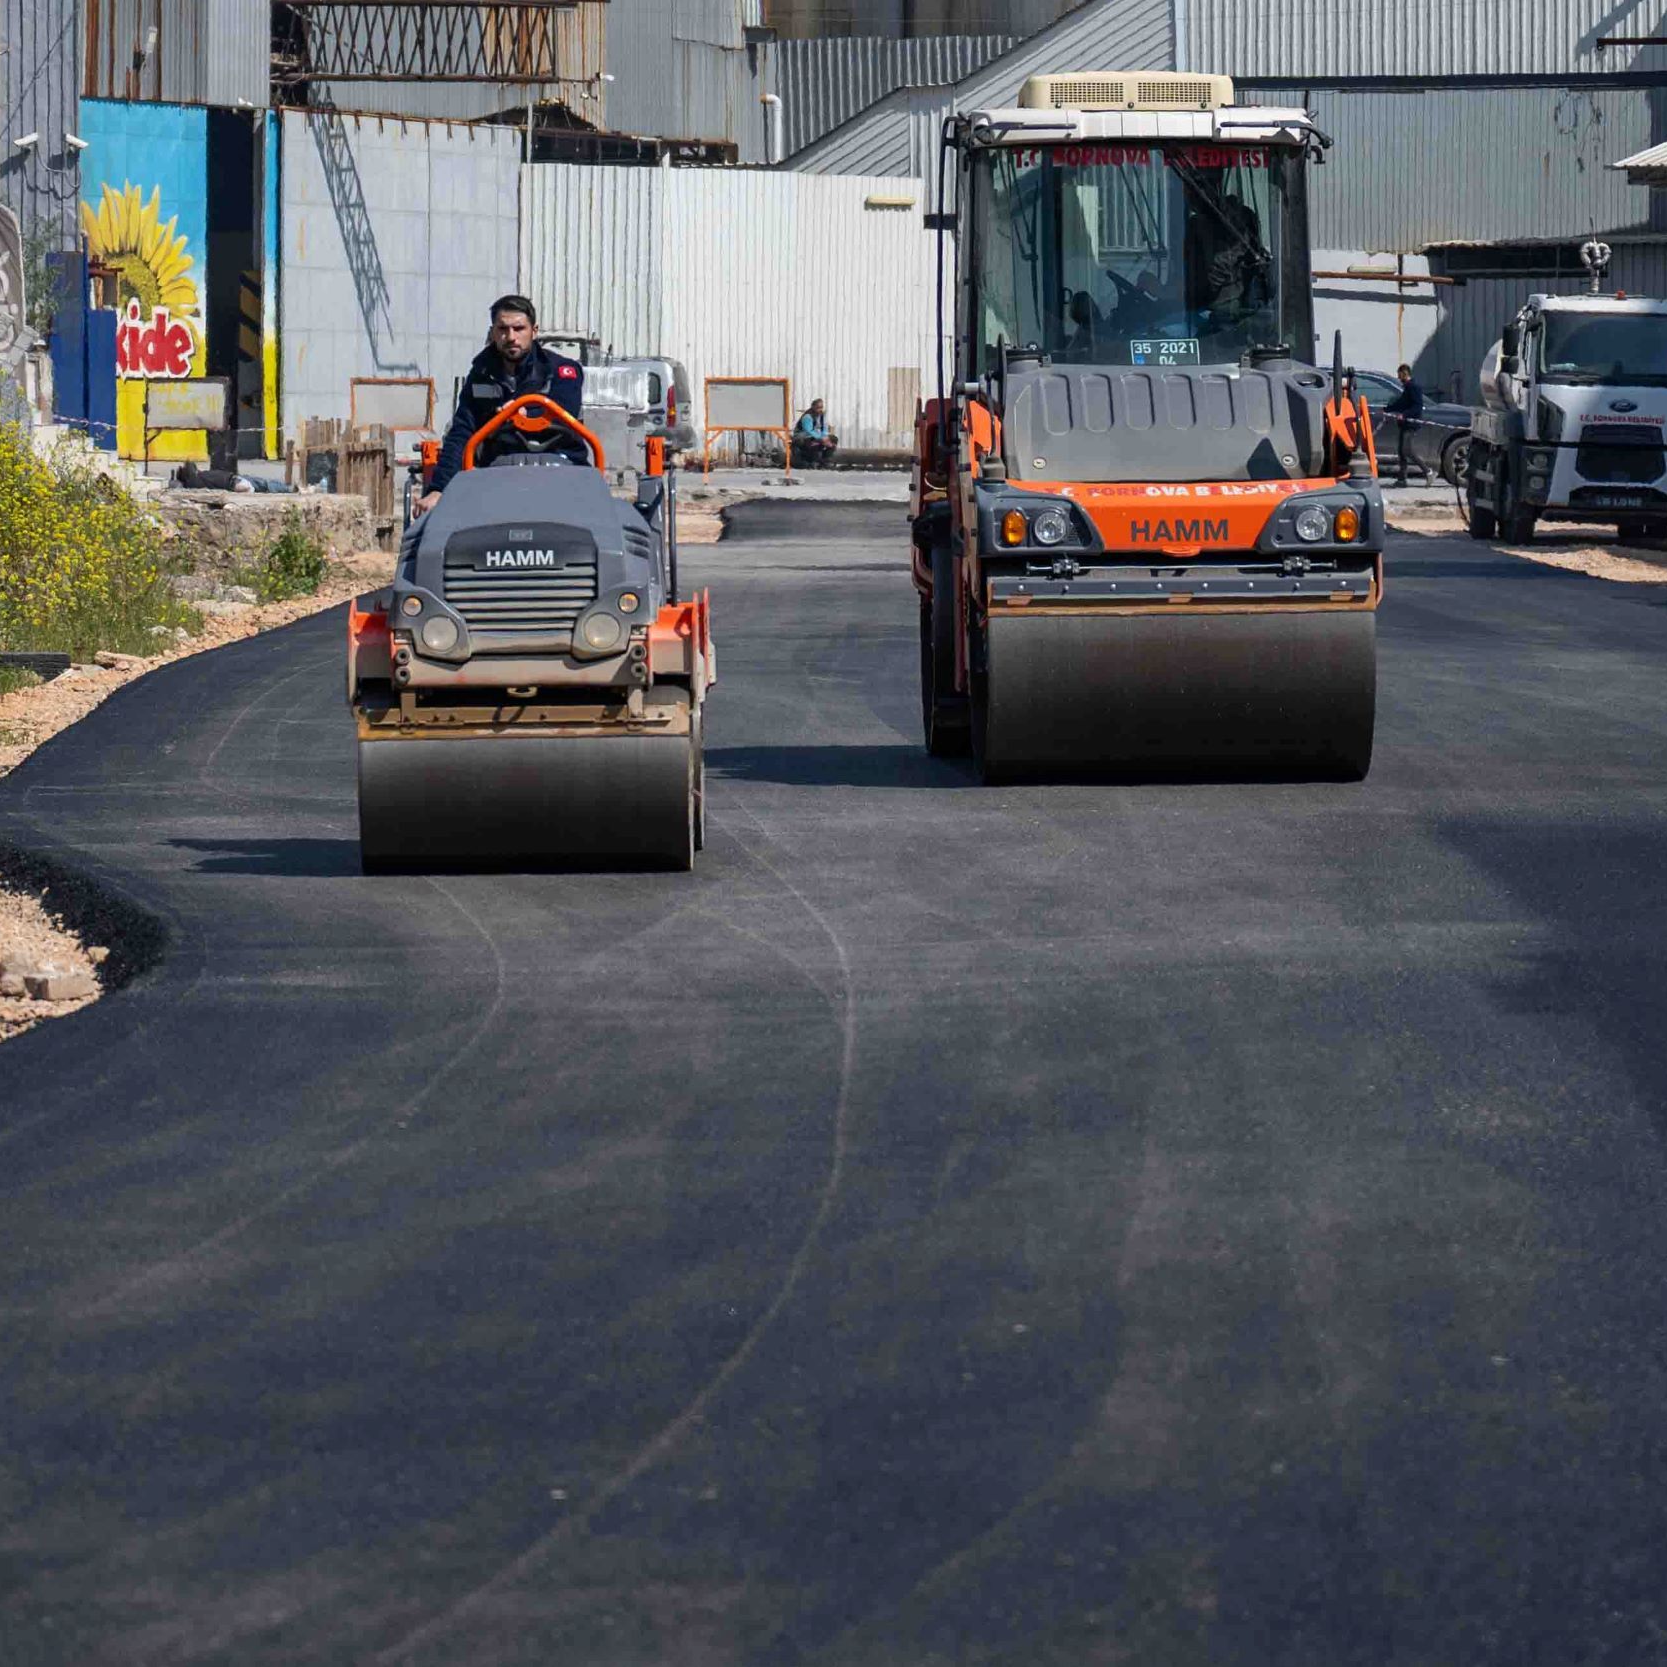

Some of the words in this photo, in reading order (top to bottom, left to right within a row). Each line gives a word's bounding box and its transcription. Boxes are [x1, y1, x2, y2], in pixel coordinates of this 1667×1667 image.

[1134, 342, 1152, 354] 35
[1160, 342, 1194, 354] 2021
[1130, 519, 1229, 542] HAMM
[486, 549, 554, 567] HAMM
